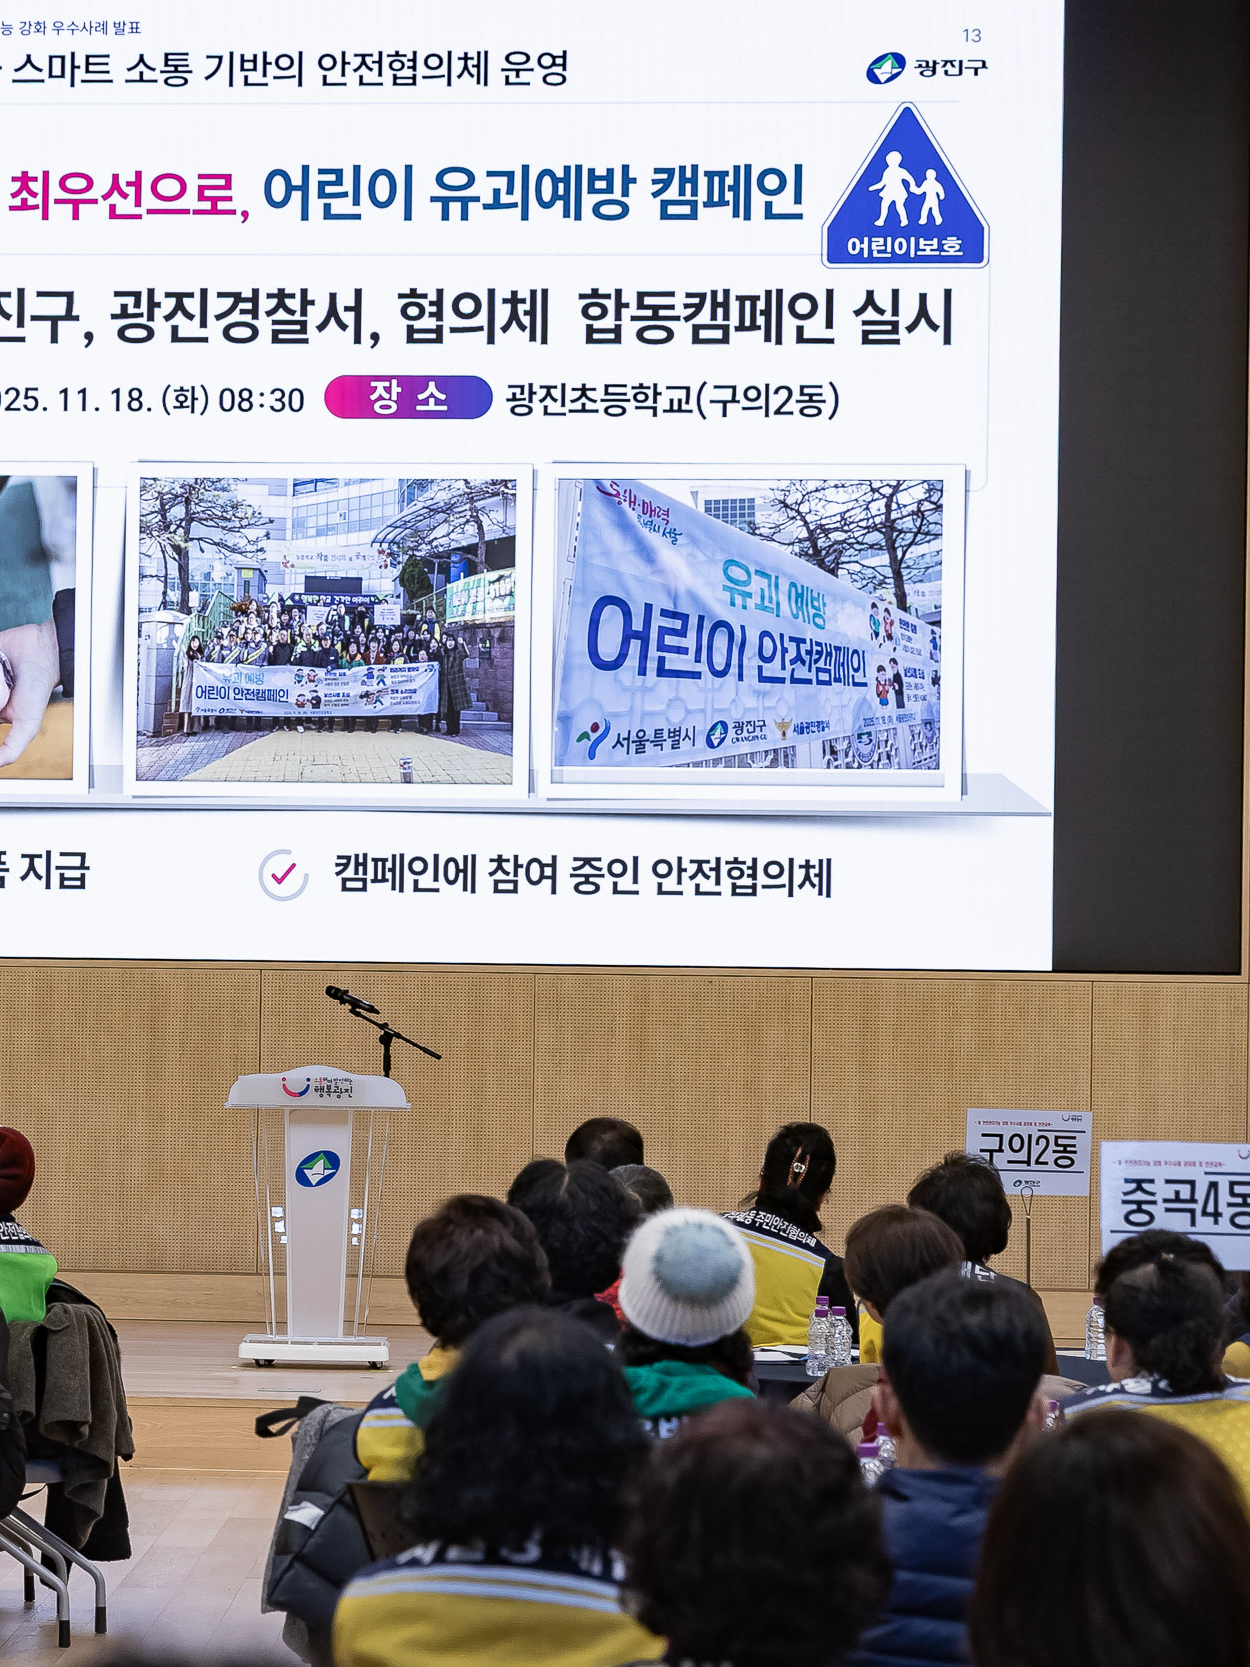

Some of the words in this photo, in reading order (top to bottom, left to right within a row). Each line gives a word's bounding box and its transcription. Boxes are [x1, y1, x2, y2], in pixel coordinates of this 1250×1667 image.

[20, 21, 46, 35] 강화
[52, 21, 107, 35] 우수사례
[114, 21, 141, 35] 발표
[963, 29, 981, 42] 13
[12, 51, 113, 88] 스마트
[125, 52, 193, 87] 소통
[204, 51, 303, 87] 기반의
[318, 50, 488, 87] 안전협의체
[501, 50, 567, 86] 운영
[914, 60, 988, 77] 광진구
[9, 170, 249, 224] 최우선으로,
[264, 164, 413, 221] 어린이
[430, 164, 637, 221] 유괴예방
[651, 164, 803, 221] 캠페인
[846, 235, 965, 260] 어린이보호
[110, 288, 380, 349] 광진경찰서,
[398, 288, 548, 345] 협의체
[579, 288, 835, 345] 합동캠페인
[853, 288, 952, 345] 실시
[59, 387, 99, 411] 11.
[111, 387, 151, 412] 18.
[162, 384, 208, 416] (화)
[219, 388, 304, 412] 08:30
[369, 379, 402, 414] 장
[416, 379, 450, 411] 소
[506, 381, 839, 420] 광진초등학교(구의2동)
[721, 558, 780, 619] 유괴
[787, 580, 828, 631] 예방
[587, 594, 748, 681] 어린이
[757, 629, 869, 689] 안전캠페인
[195, 684, 230, 700] 어린이
[233, 686, 289, 703] 안전캠페인
[612, 724, 696, 756] 서울특별시
[732, 719, 767, 736] 광진구
[20, 850, 90, 890] 지급
[335, 853, 476, 894] 캠페인에
[488, 854, 557, 895] 참여
[570, 856, 639, 895] 중인
[652, 856, 831, 898] 안전협의체
[979, 1131, 1078, 1169] 구의2동
[1121, 1177, 1250, 1230] 중곡4동
